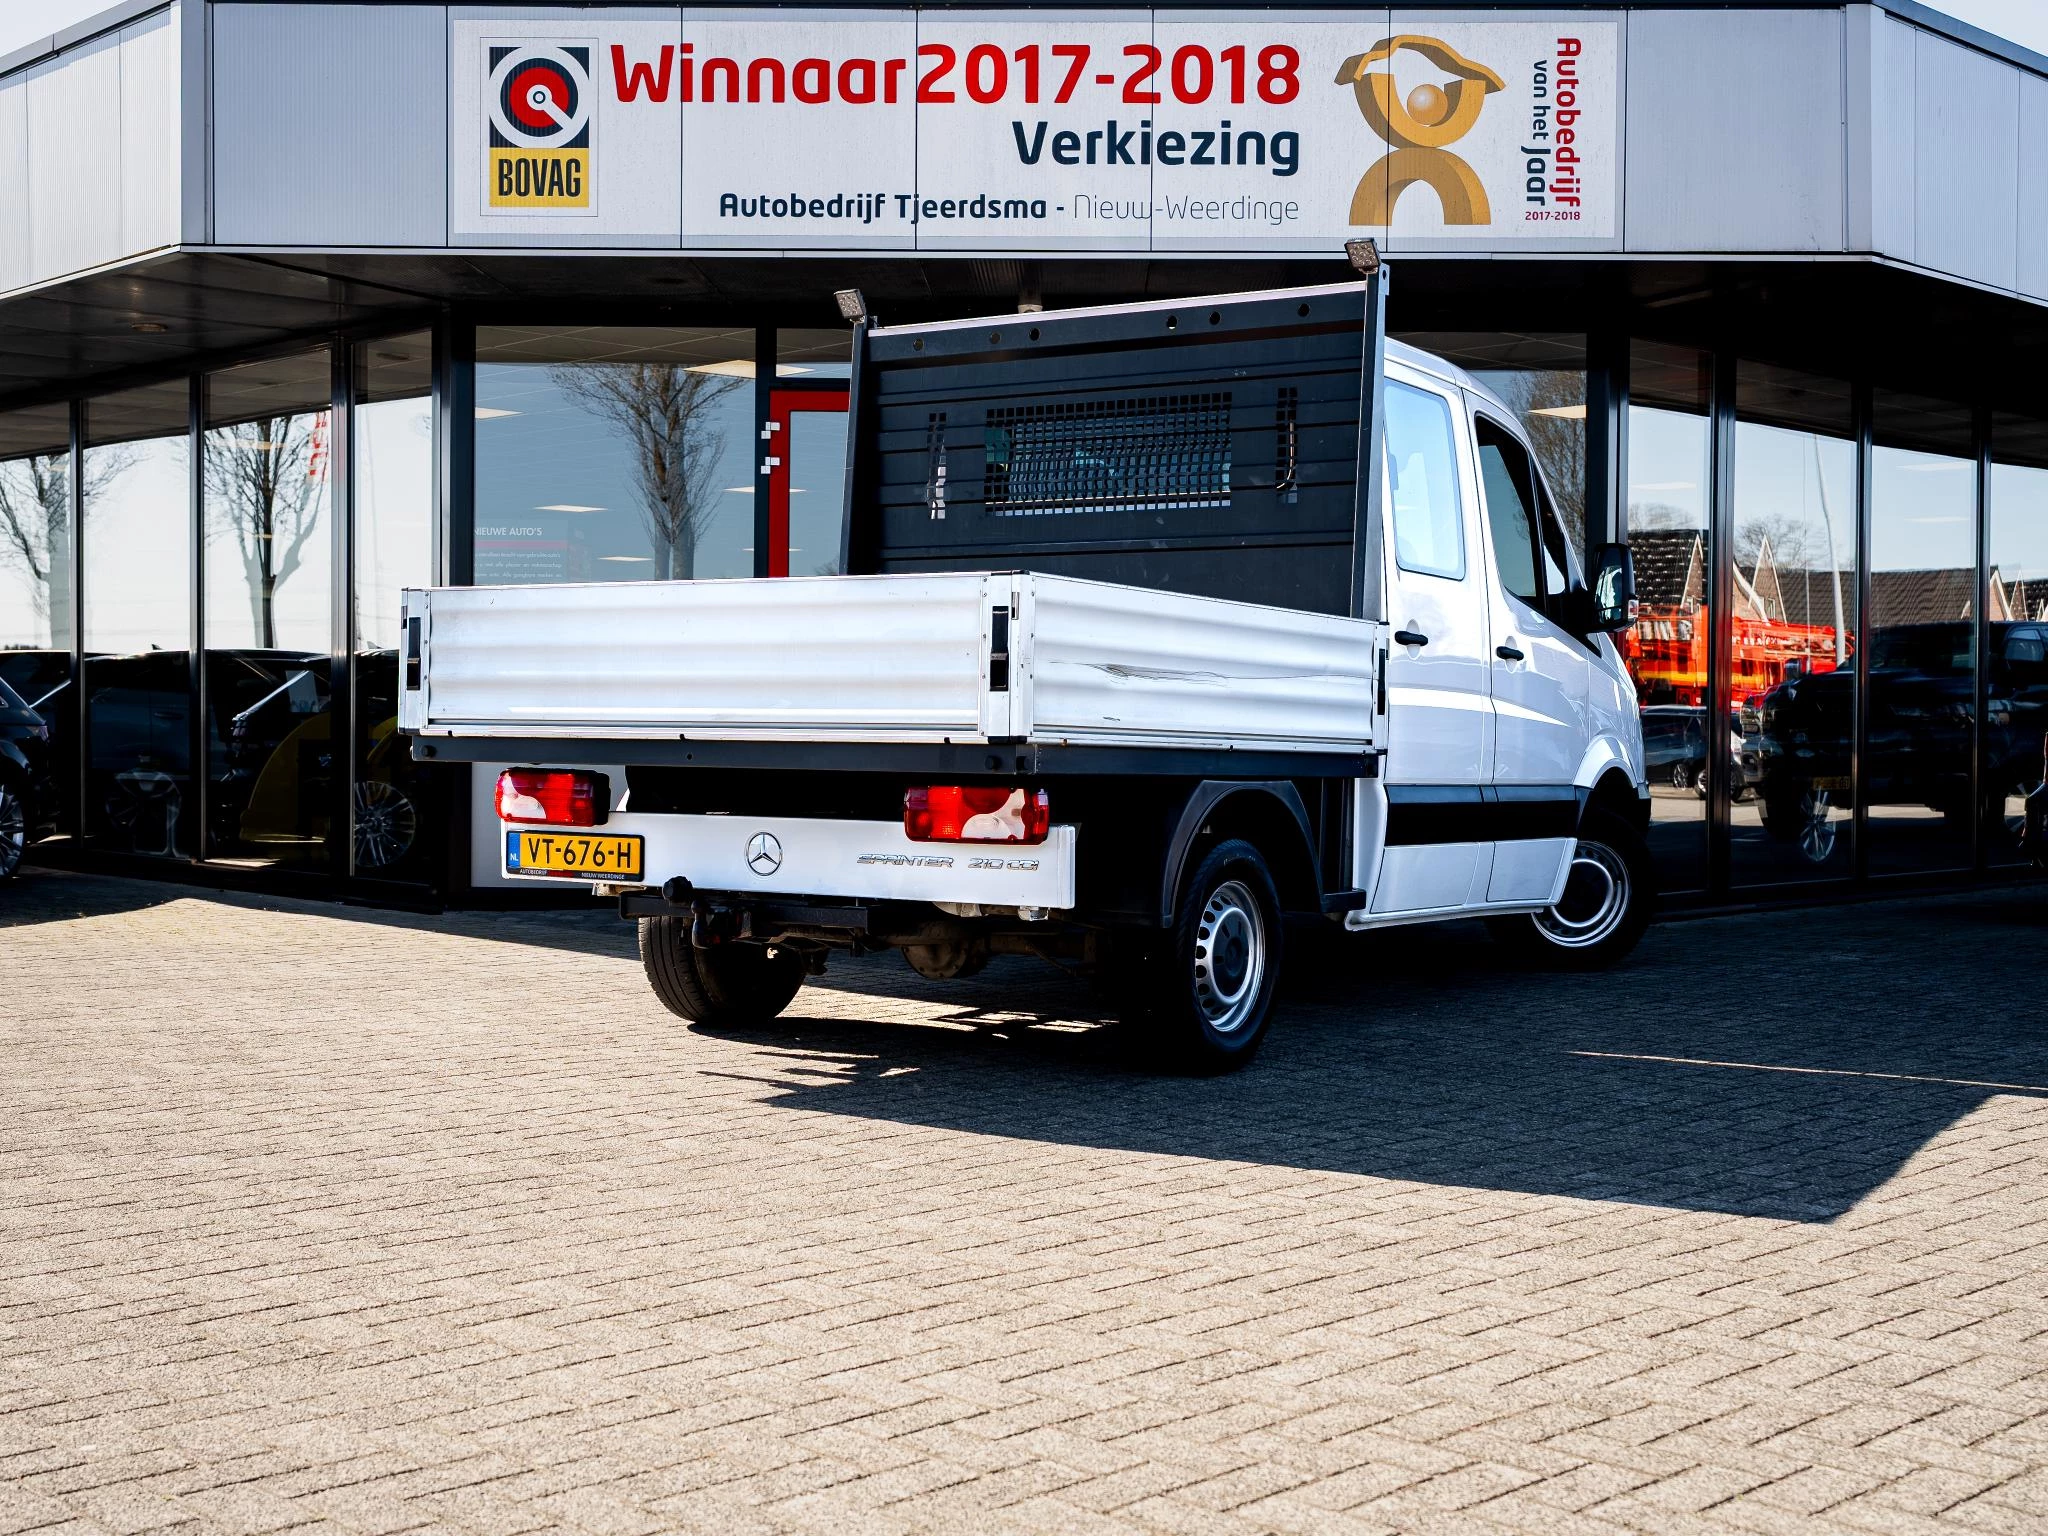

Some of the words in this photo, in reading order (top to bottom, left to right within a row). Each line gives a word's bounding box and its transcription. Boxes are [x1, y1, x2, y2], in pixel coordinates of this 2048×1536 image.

[610, 44, 906, 104] Winnaar
[916, 43, 1300, 105] 2017-2018
[1533, 60, 1548, 98] van
[1532, 105, 1551, 140] het
[1549, 37, 1582, 207] Autobedrijf
[1012, 119, 1300, 177] Verkiezing
[498, 157, 581, 197] BOVAG
[1520, 145, 1552, 207] Jaar
[719, 192, 886, 224] Autobedrijf
[894, 193, 1047, 225] Tjeerdsma
[1073, 194, 1299, 225] Nieuw-Weerdinge
[1525, 211, 1581, 221] 2017-2018
[509, 527, 542, 536] AUTO'S
[510, 853, 519, 861] NL
[527, 837, 631, 869] VT-676-H
[856, 853, 954, 869] SPRINTER
[967, 857, 1004, 870] 210
